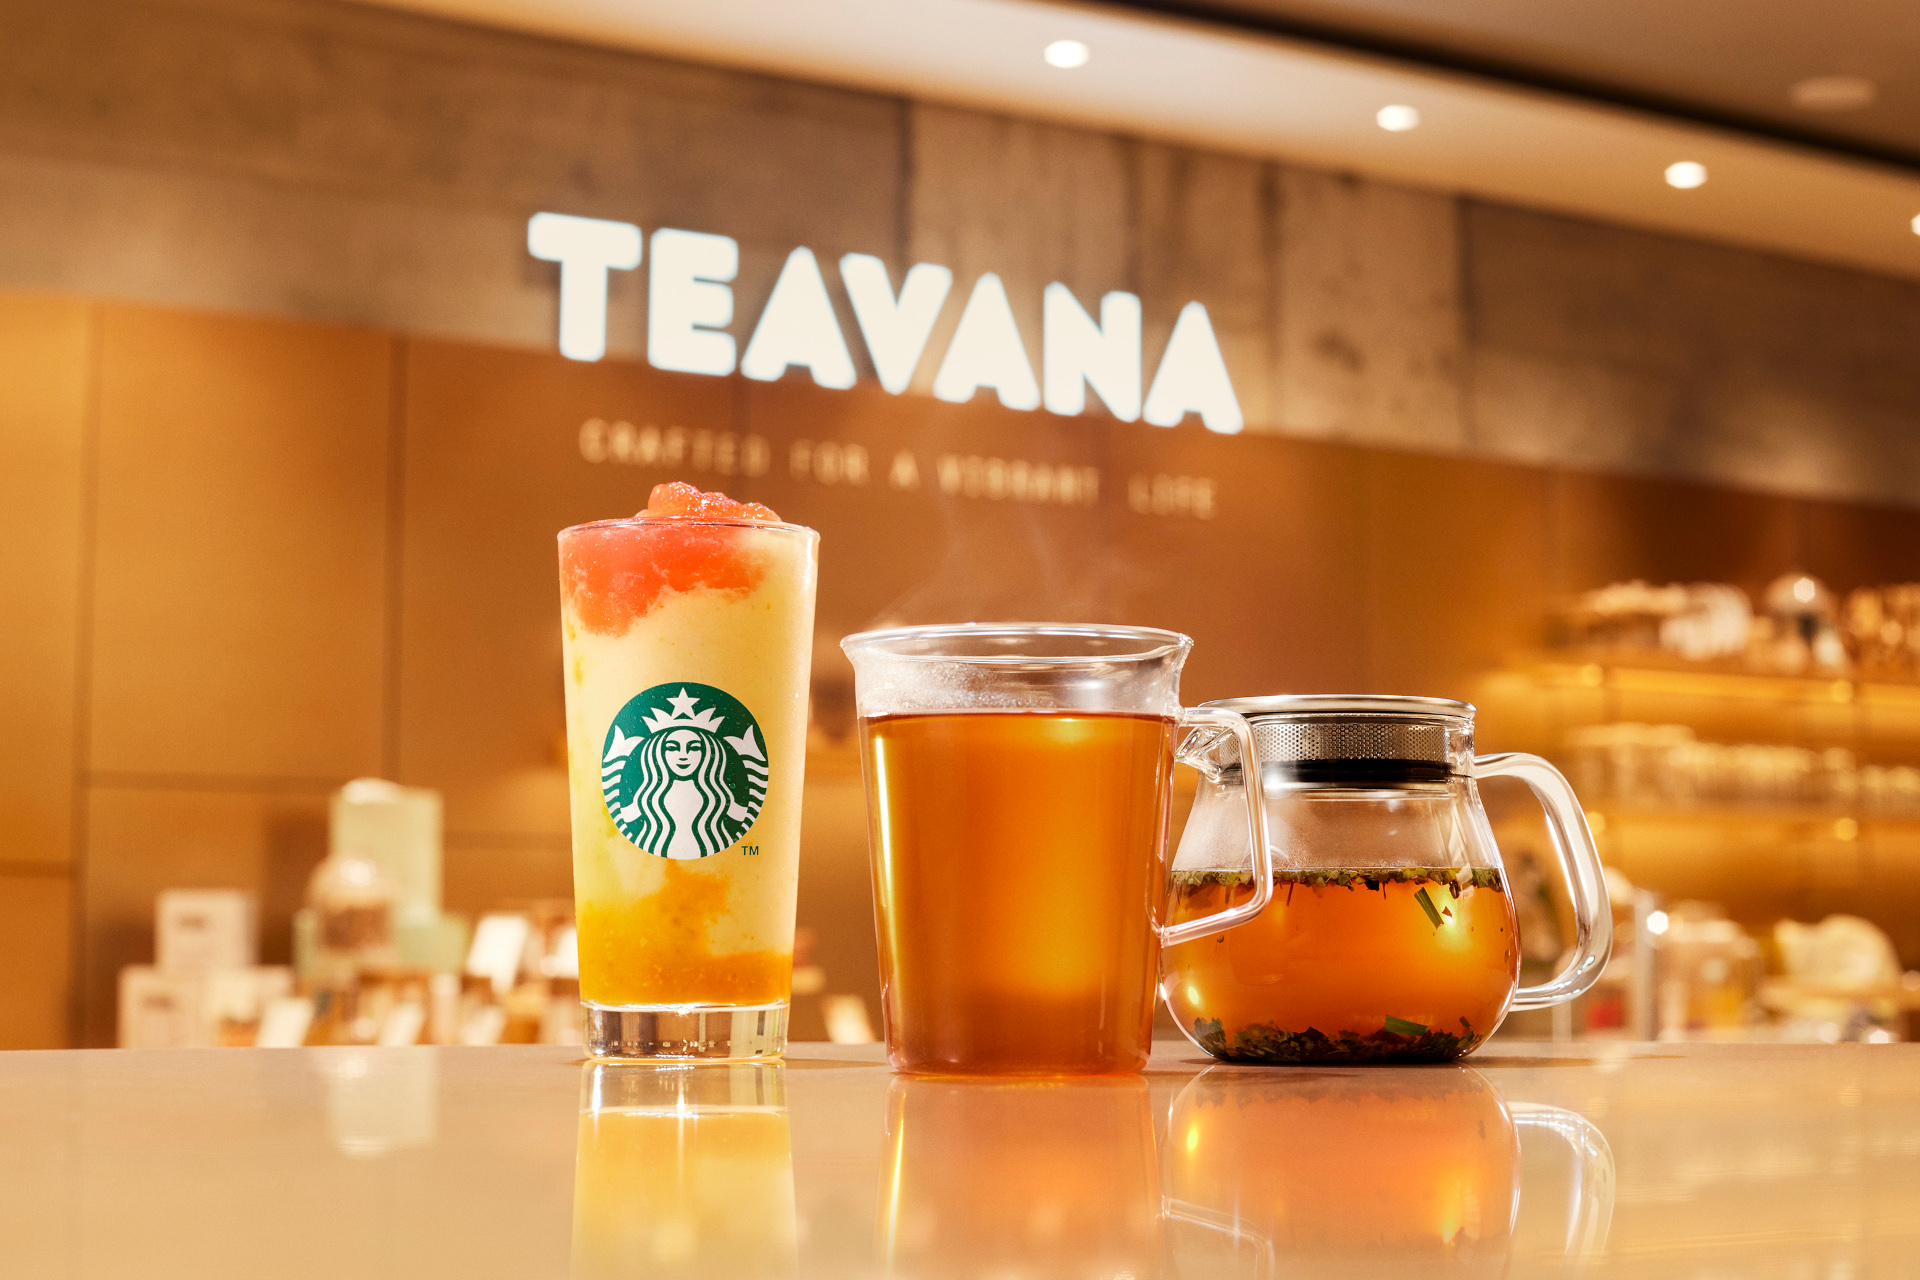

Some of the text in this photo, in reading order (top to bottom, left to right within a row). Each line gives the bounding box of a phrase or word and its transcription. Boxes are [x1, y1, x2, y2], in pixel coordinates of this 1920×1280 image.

[527, 212, 1244, 434] TEAVANA
[578, 417, 772, 478] CRAFTED
[788, 437, 872, 485] FOR
[888, 450, 920, 492] A
[741, 845, 759, 856] TM
